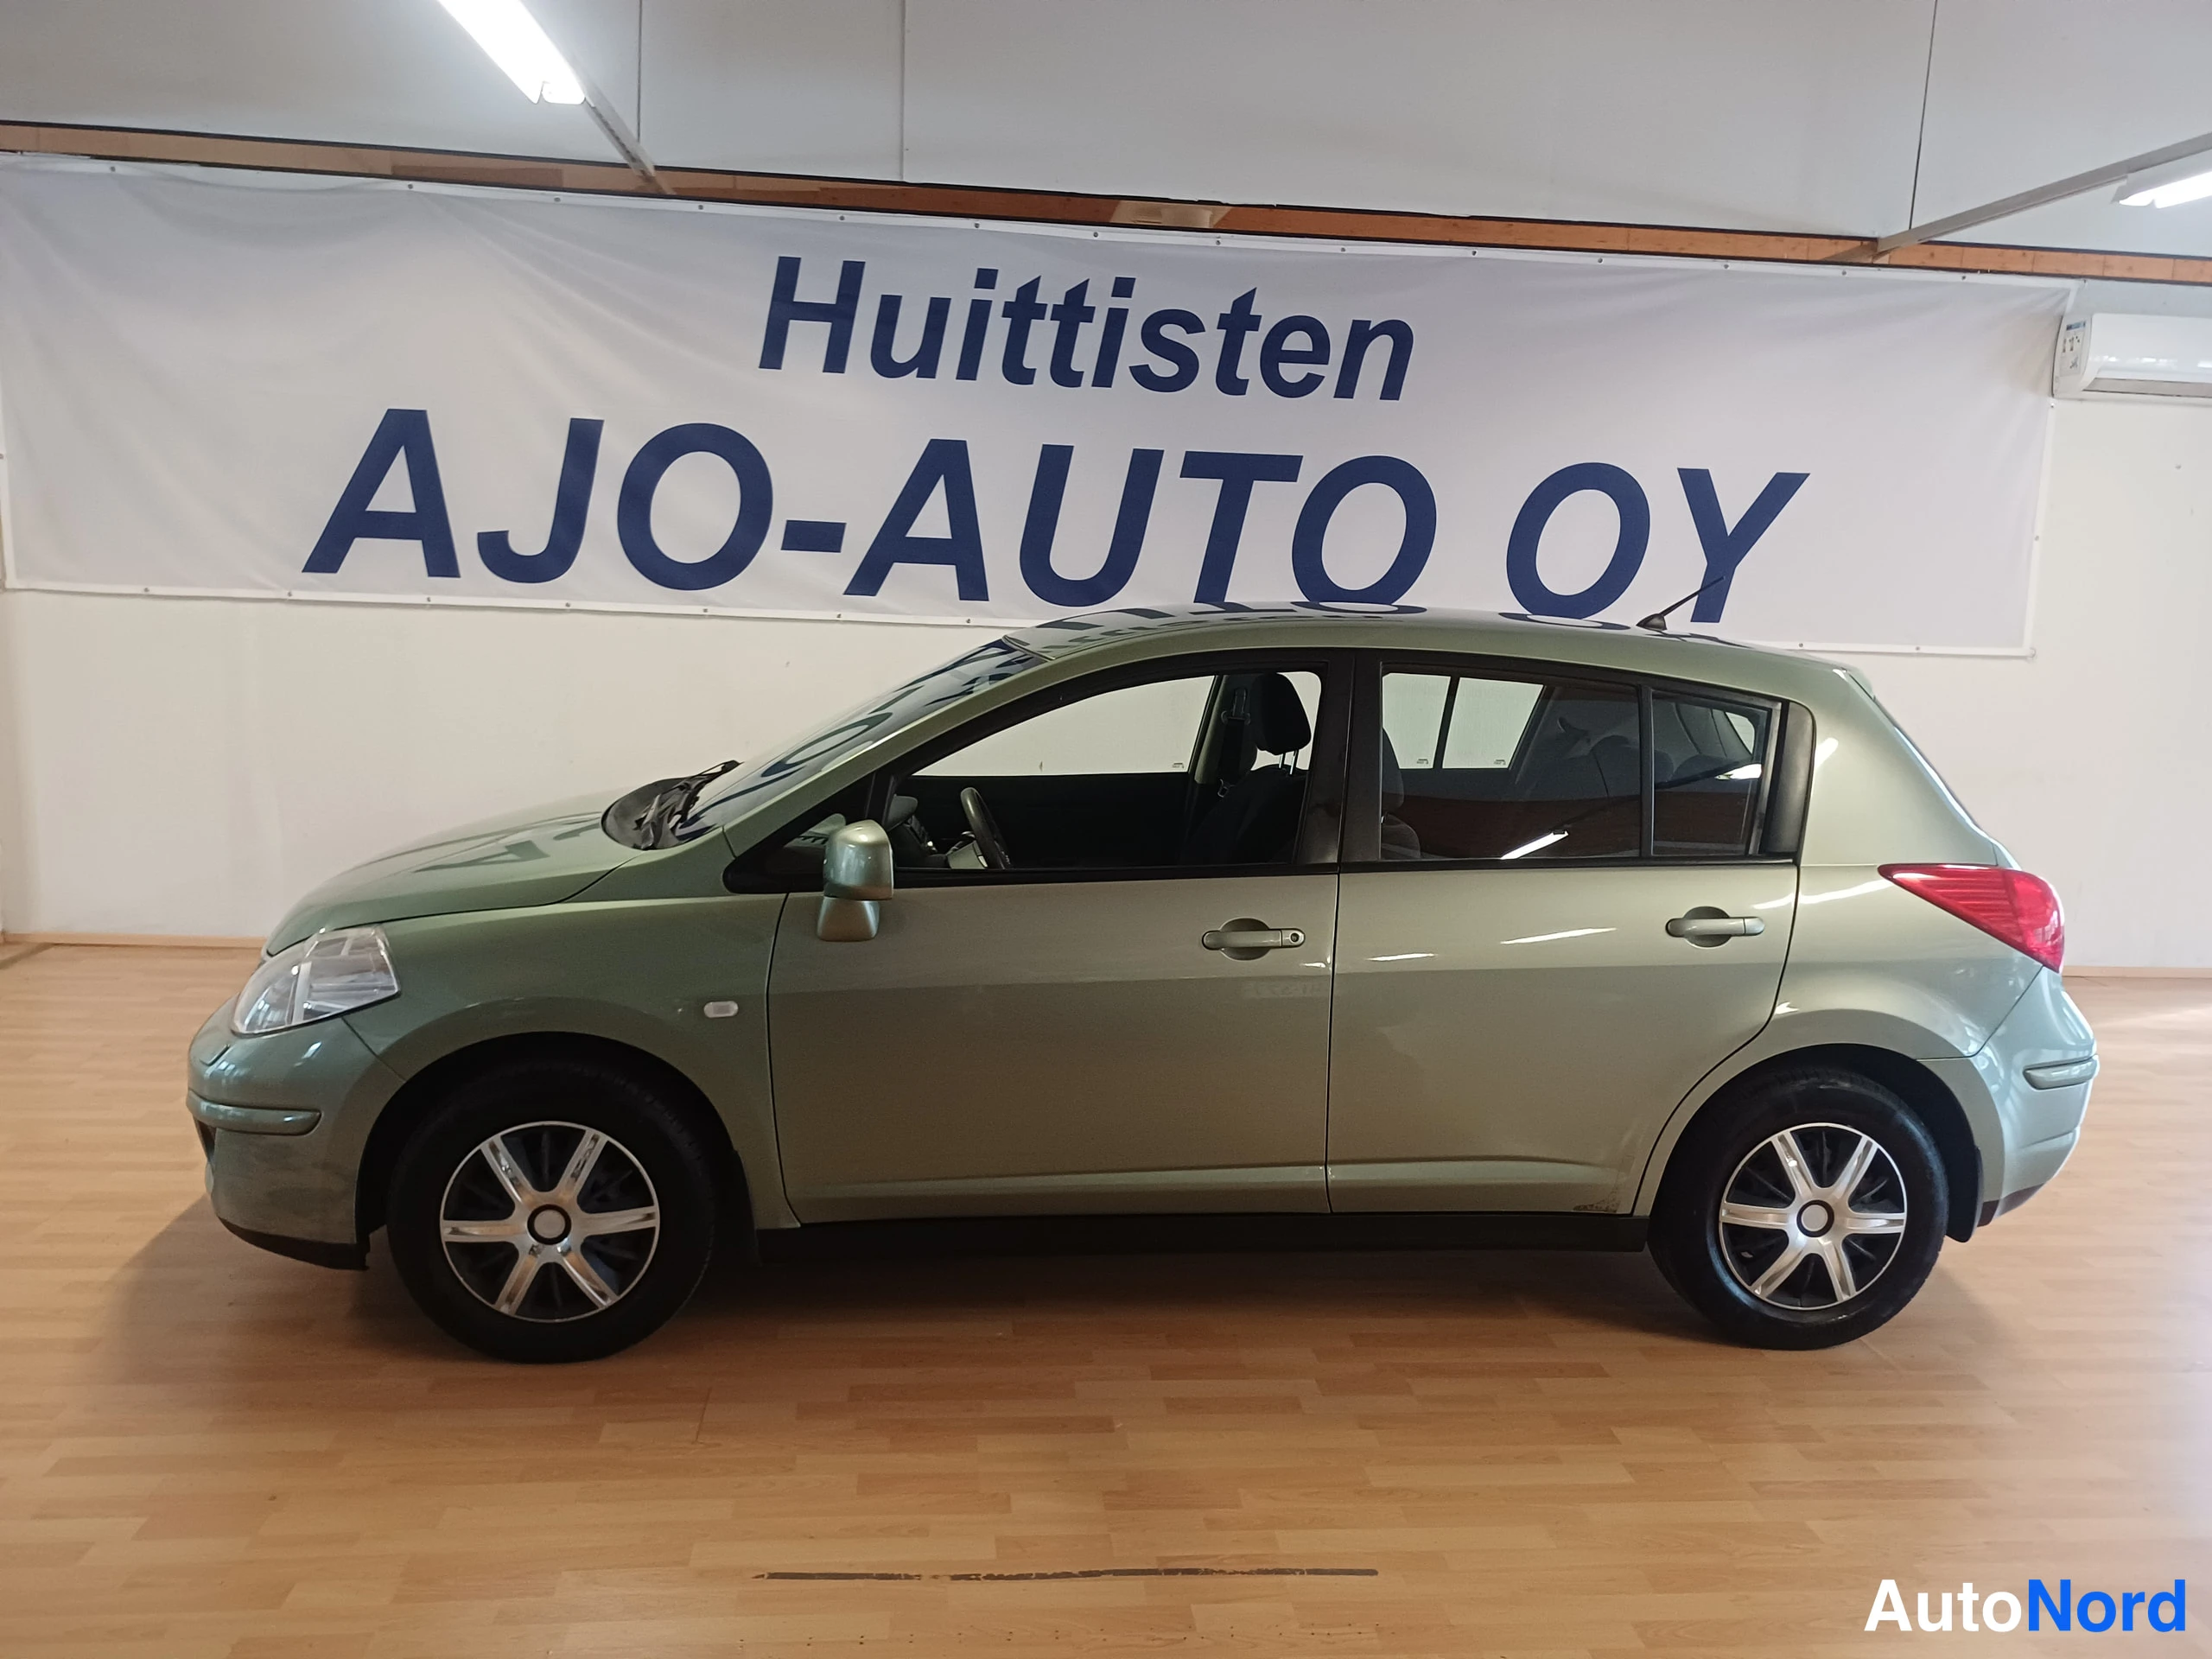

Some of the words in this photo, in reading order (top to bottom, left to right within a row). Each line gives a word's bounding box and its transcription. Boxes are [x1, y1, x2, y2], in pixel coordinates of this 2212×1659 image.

[760, 256, 1414, 400] Huittisten
[302, 409, 1437, 607] AJO-AUTO
[1506, 462, 1809, 624] OY
